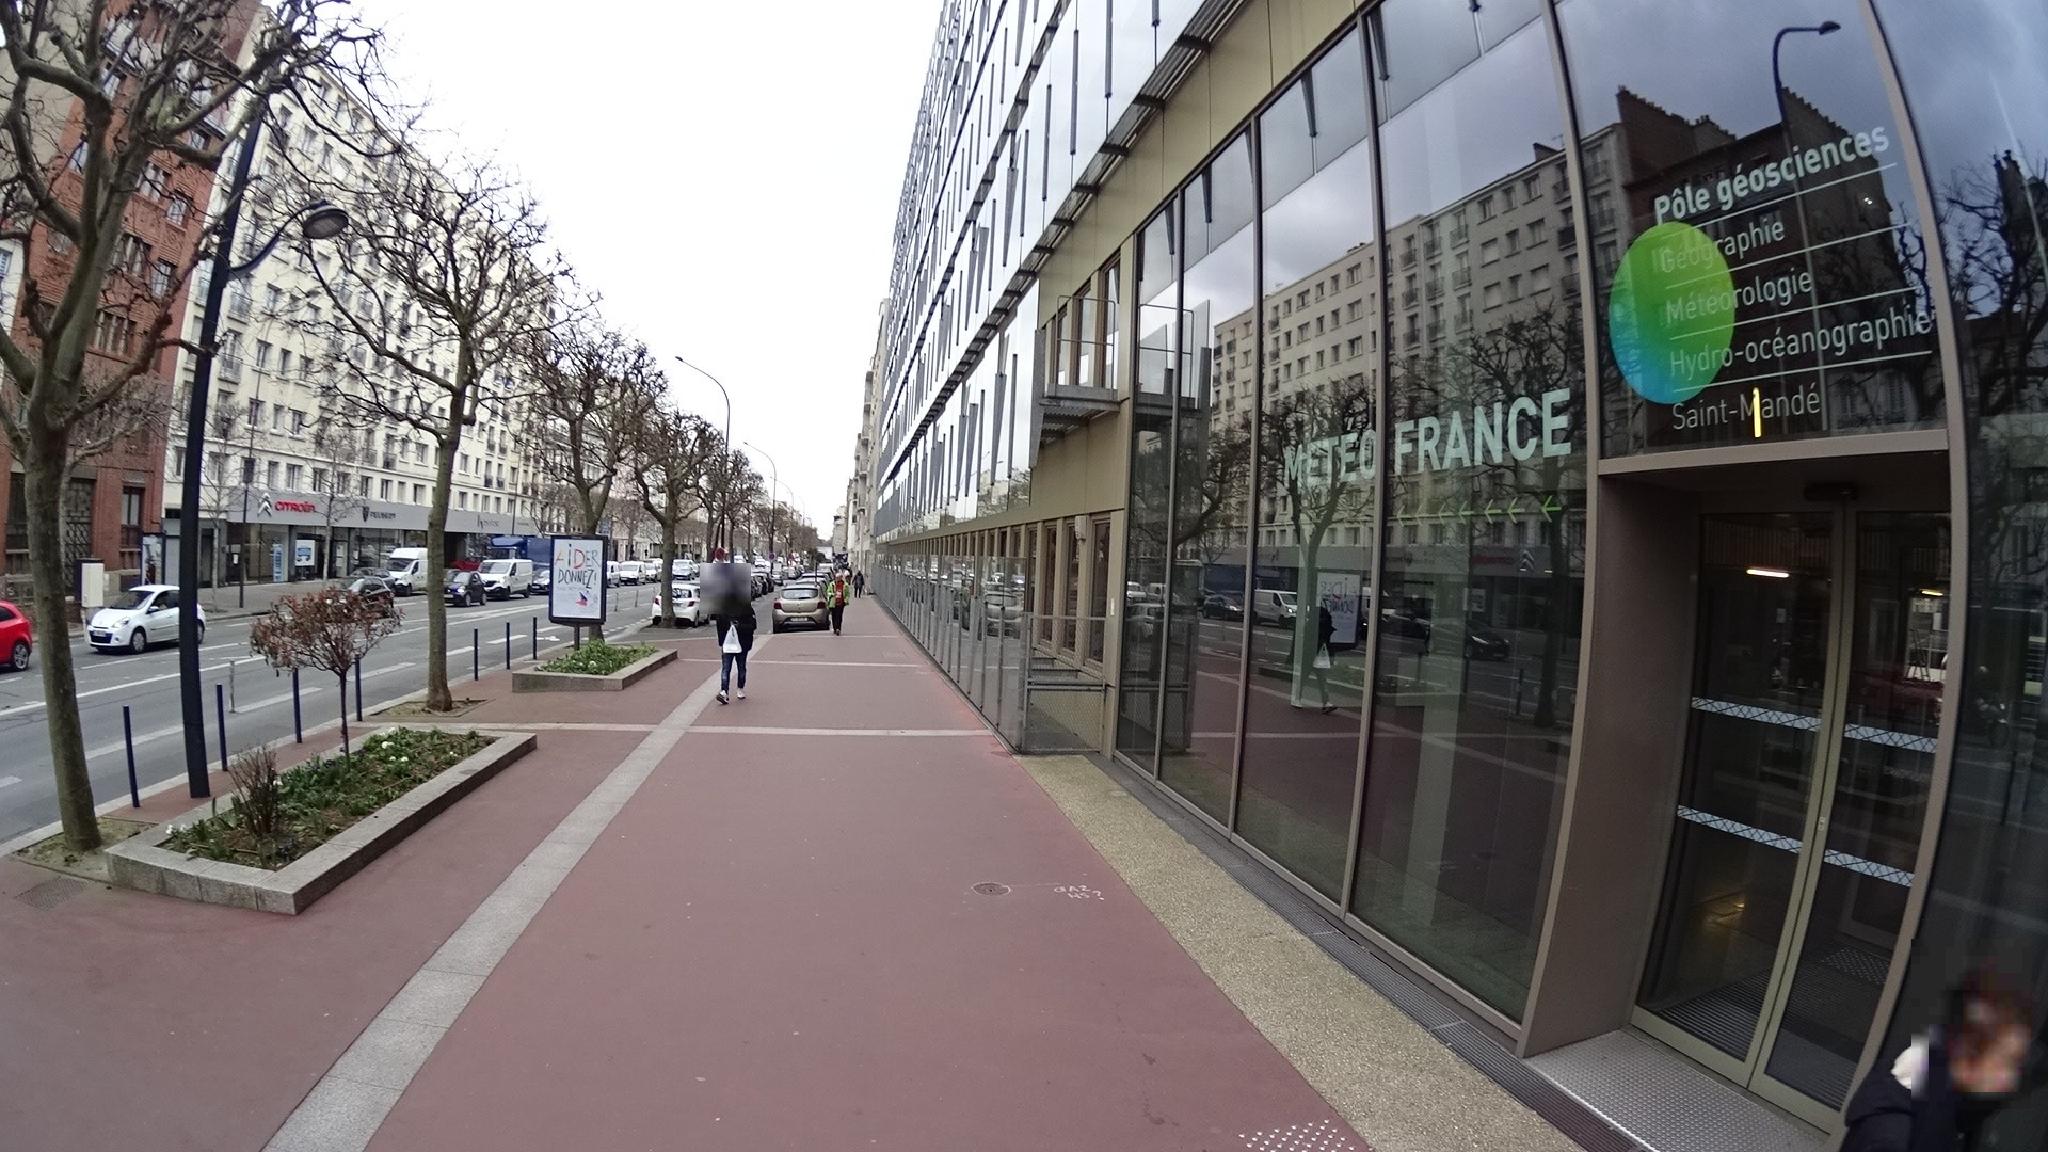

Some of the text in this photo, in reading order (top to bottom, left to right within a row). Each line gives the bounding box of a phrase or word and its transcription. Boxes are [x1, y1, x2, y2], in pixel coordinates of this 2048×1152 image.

[1654, 126, 1889, 225] Pôle géosciences
[1661, 217, 1785, 273] Géographie
[1666, 268, 1813, 326] Météorologie
[1670, 300, 1932, 380] Hydro-océanographie
[1394, 388, 1571, 475] FRANCE
[1673, 382, 1821, 430] Saint-Mandé
